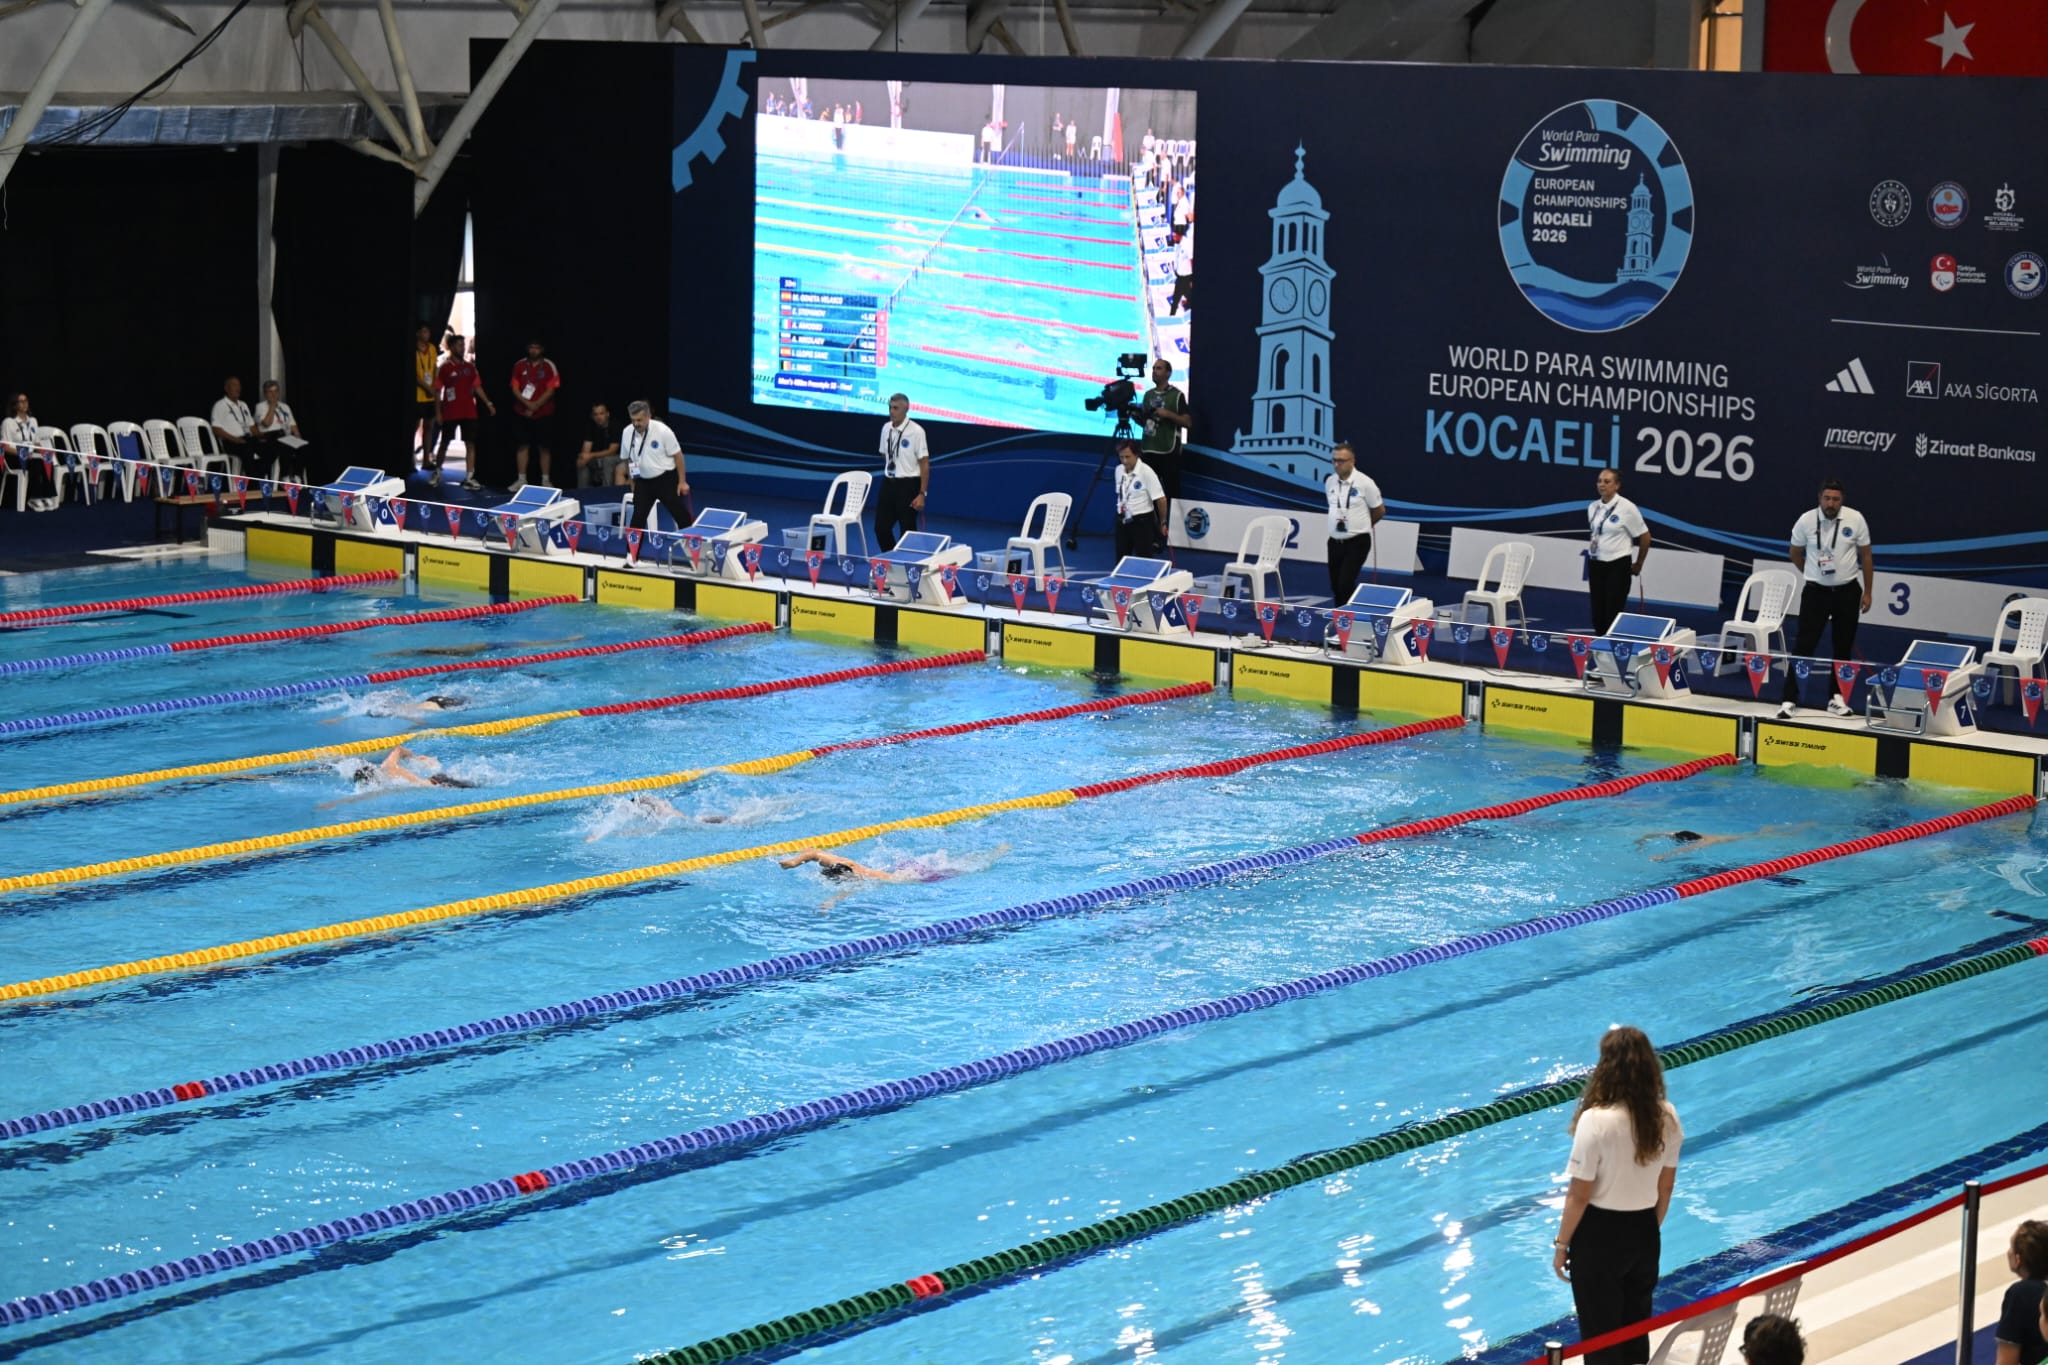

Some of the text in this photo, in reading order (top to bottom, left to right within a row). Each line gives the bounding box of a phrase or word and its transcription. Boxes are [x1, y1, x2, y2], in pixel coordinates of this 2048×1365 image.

[1541, 129, 1600, 142] World Para
[1538, 142, 1631, 170] Swimming
[1534, 178, 1595, 191] EUROPEAN
[1533, 194, 1628, 209] CHAMPIONSHIPS
[1532, 210, 1593, 227] KOCAELİ
[1532, 229, 1568, 243] 2026
[1856, 272, 1909, 288] Swimming
[1448, 345, 1729, 388] WORLD PARA SWIMMING
[1907, 379, 1933, 395] AXA
[1944, 383, 2039, 403] AXA SİGORTA
[1428, 373, 1756, 421] EUROPEAN CHAMPIONSHIPS
[1424, 408, 1755, 482] KOCAELİ 2026
[1929, 439, 2036, 462] Ziraat Bankası
[381, 508, 388, 520] 0
[557, 531, 562, 543] 1
[1281, 518, 1300, 549] 2
[1887, 582, 1911, 616] 3
[1169, 608, 1176, 620] 4
[1410, 637, 1417, 650] 5
[1674, 669, 1681, 682] 6
[1960, 705, 1967, 719] 7
[1774, 739, 1827, 751] SWISS TIMING
